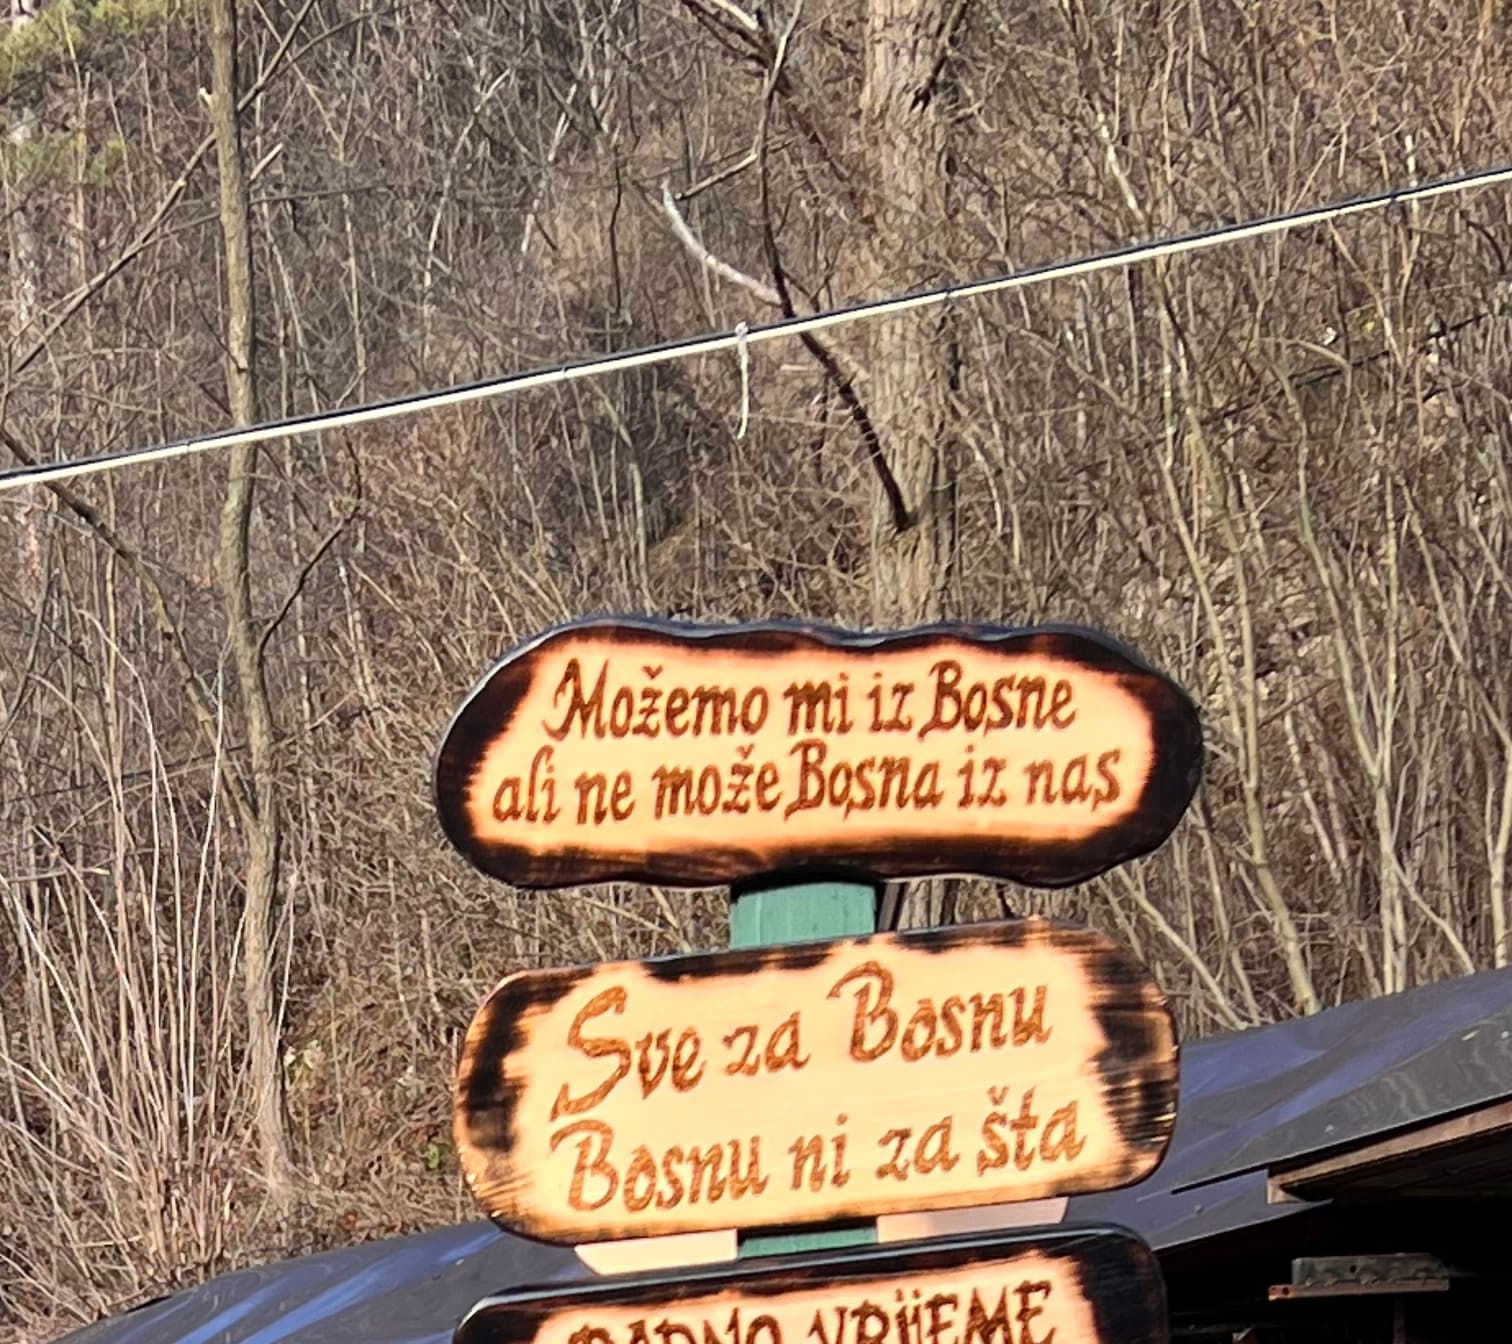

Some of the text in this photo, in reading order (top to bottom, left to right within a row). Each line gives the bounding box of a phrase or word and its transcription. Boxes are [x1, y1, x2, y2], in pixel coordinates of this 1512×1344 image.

[543, 657, 1077, 741] Možemo mi iz Bosne
[493, 739, 1122, 825] ali ne može Bosna iz nas
[549, 960, 1052, 1122] Sve za Bosnu
[551, 1088, 1088, 1213] Bosnu ni za šta
